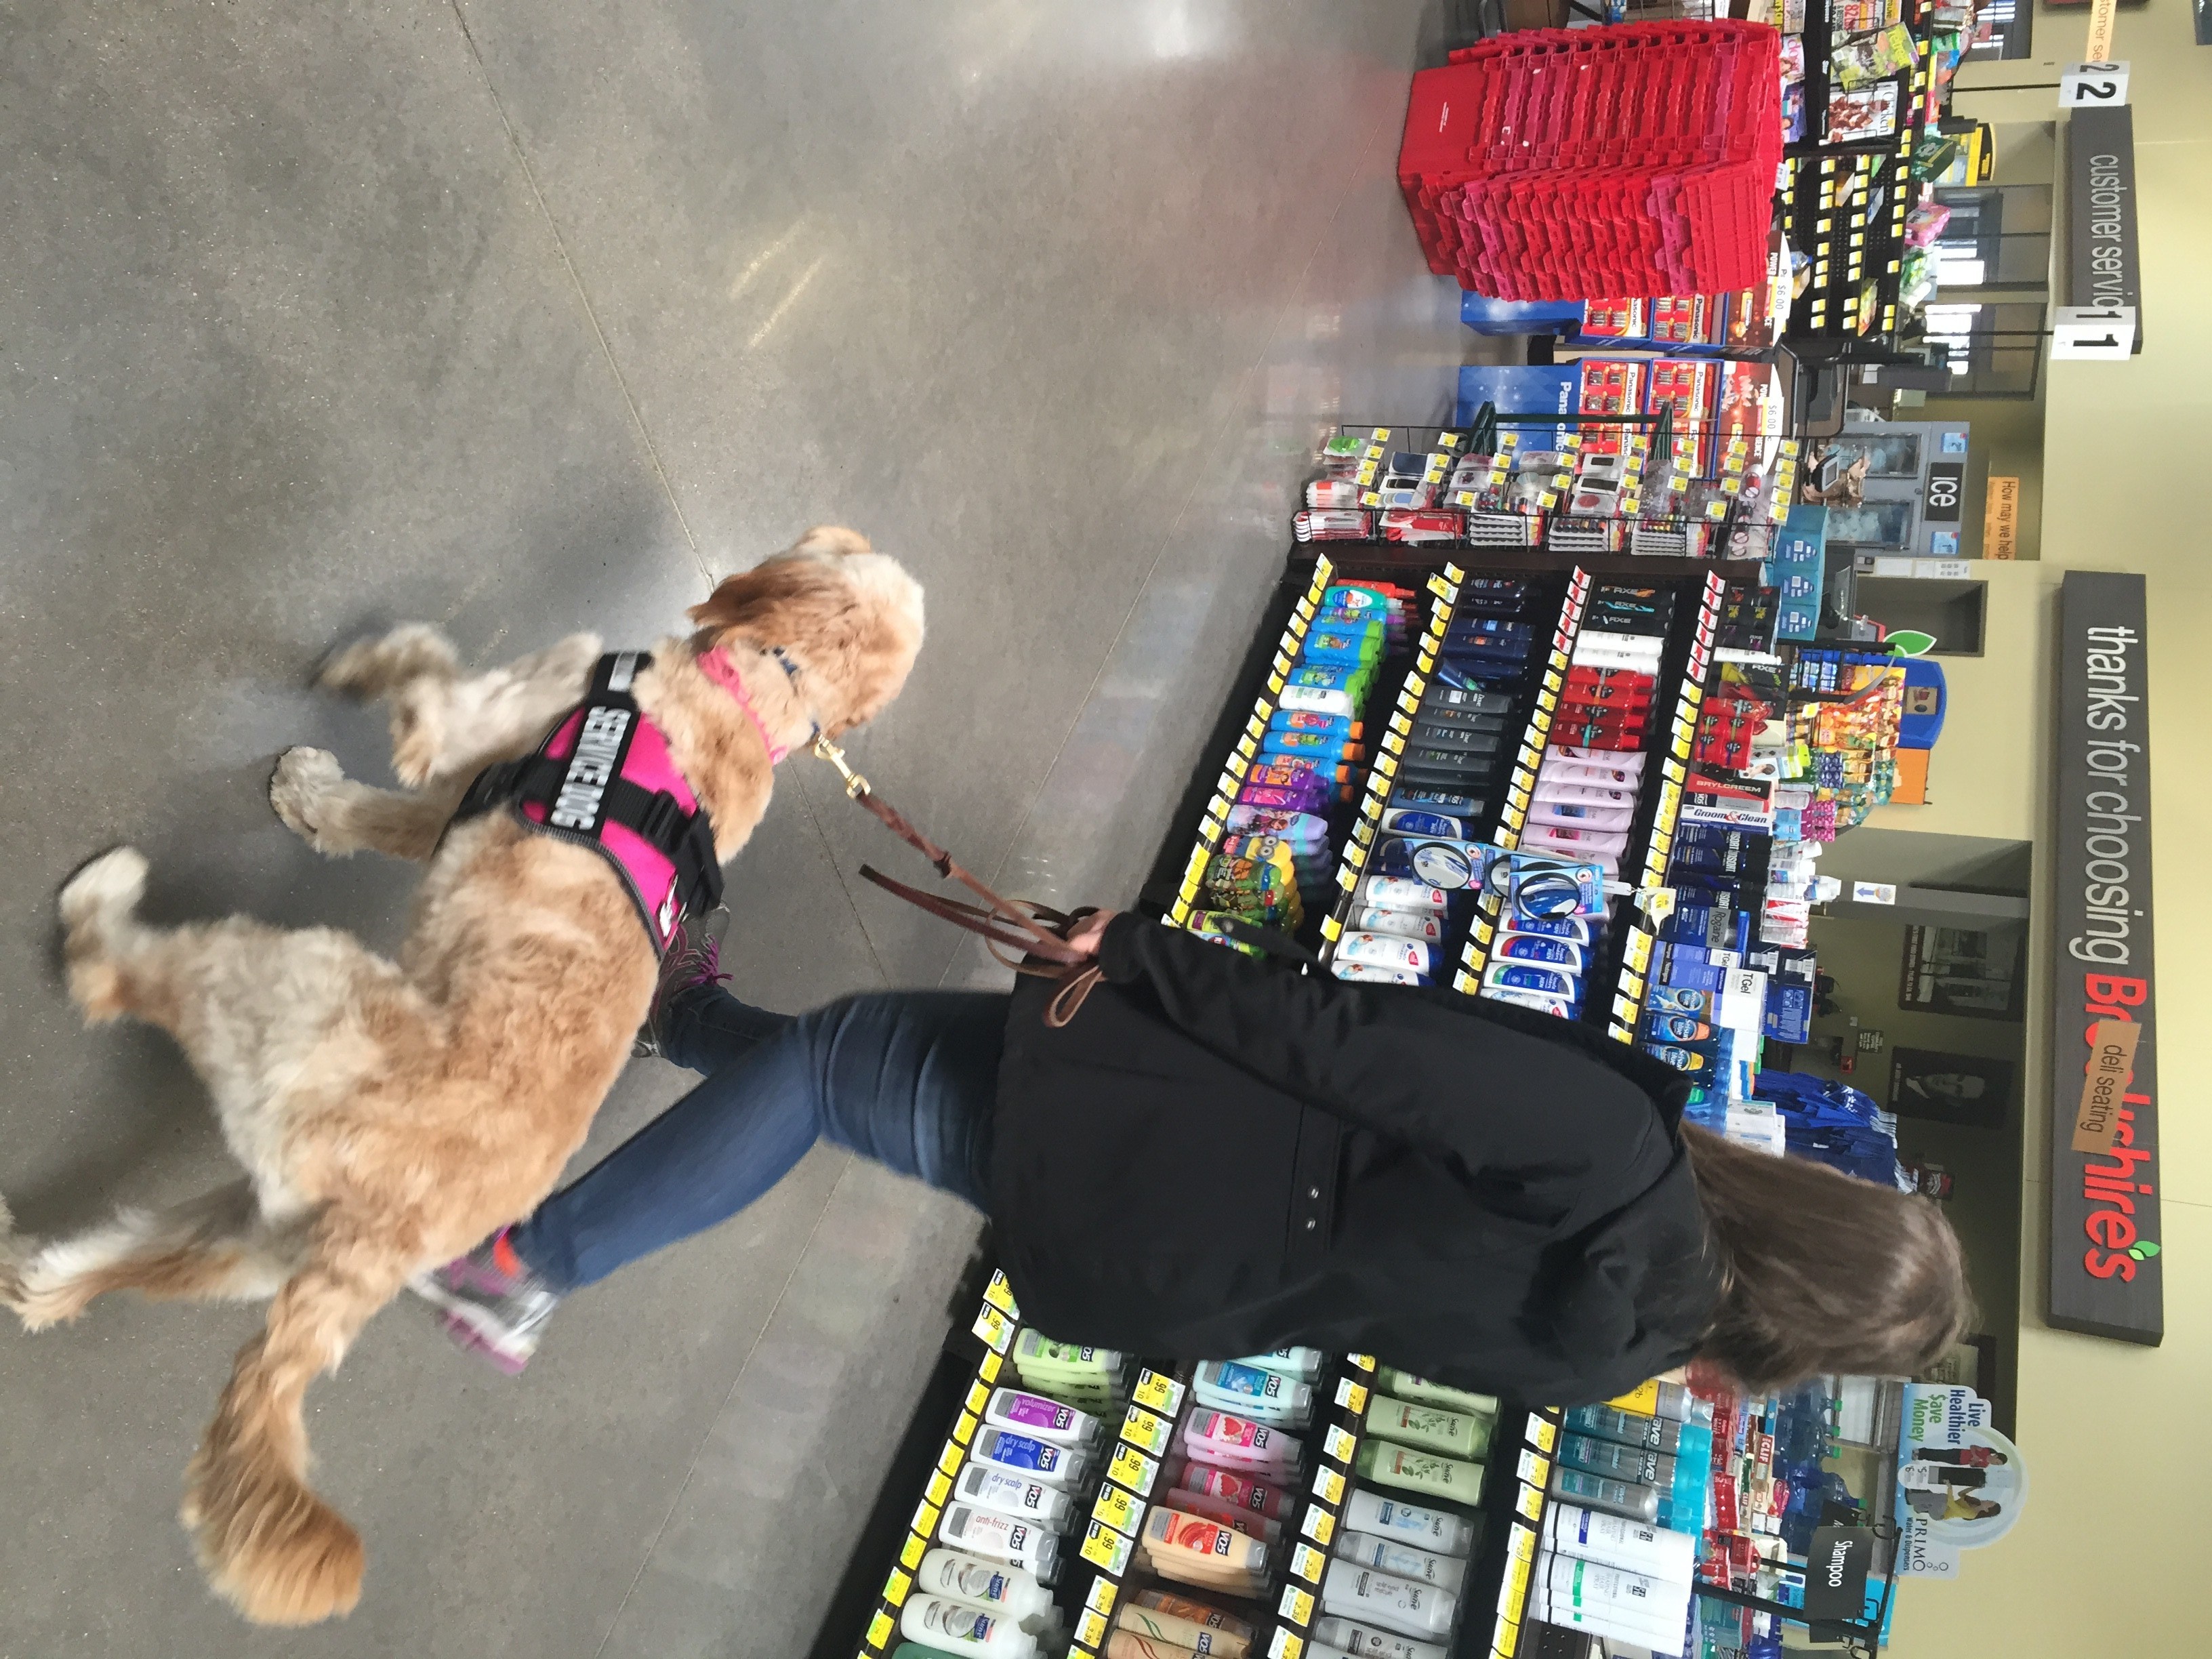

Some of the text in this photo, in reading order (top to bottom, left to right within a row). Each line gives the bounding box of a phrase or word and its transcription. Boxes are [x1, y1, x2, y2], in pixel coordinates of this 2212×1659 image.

[2080, 64, 2119, 73] 2
[2076, 82, 2116, 100] 2
[1879, 91, 1895, 134] Chicken
[2089, 155, 2133, 307] customer servic
[1769, 252, 1778, 275] POWER
[1692, 298, 1703, 339] Panasonic
[2076, 310, 2123, 319] 1
[2073, 334, 2119, 348] 1
[1625, 372, 1636, 413] Panasonic
[1694, 371, 1704, 412] Panasonic
[1555, 381, 1572, 451] Panaonic
[1994, 480, 2015, 560] How may we help
[1475, 693, 1485, 707] Dove
[550, 705, 632, 830] SERVICE DOG
[1696, 780, 1761, 793] BRYLCREEM
[1694, 808, 1727, 819] Groom
[1738, 813, 1767, 823] Clean
[1710, 910, 1727, 943] Rogaine
[2068, 626, 2154, 1283] thanks for choosing Brhire's
[1682, 1019, 1692, 1040] Selsun
[2078, 1044, 2128, 1133] deli seating
[1082, 1347, 1092, 1361] O5
[1266, 1376, 1279, 1397] VO5
[1021, 1399, 1056, 1412] volumizer
[1347, 1393, 1357, 1409] 2.39
[1928, 1394, 1949, 1424] $ave
[1055, 1408, 1069, 1428] VO5
[1907, 1399, 1929, 1442] Money
[1947, 1389, 1967, 1445] Healthier
[1967, 1403, 1986, 1427] Live
[1448, 1417, 1459, 1437] Suave
[1650, 1418, 1662, 1446] rave
[1005, 1435, 1036, 1453] dry scalp
[1255, 1428, 1268, 1449] VO5
[1040, 1448, 1054, 1470] VO5
[1334, 1441, 1345, 1458] 2.39
[1759, 1443, 1769, 1462] CLIF
[1442, 1463, 1454, 1484] Suave
[1645, 1452, 1658, 1481] rave
[991, 1473, 1023, 1491] dry scalp
[1324, 1481, 1334, 1500] 2.39
[1026, 1486, 1040, 1508] VO5
[1252, 1488, 1265, 1509] VO5
[1618, 1485, 1626, 1504] rave
[975, 1516, 1009, 1531] anti-frizz
[1313, 1522, 1323, 1540] 2.39
[1432, 1517, 1443, 1538] Suave
[1906, 1517, 1914, 1534] Water
[1011, 1528, 1025, 1550] VO5
[1216, 1532, 1229, 1555] VO5
[1912, 1518, 1928, 1572] PRIMO
[1826, 1540, 1853, 1587] Shampoo
[1903, 1540, 1913, 1571] Dispensers
[1303, 1559, 1313, 1578] 2.39
[1425, 1558, 1437, 1580] Suave
[991, 1577, 1004, 1599] Suave
[1291, 1601, 1302, 1620] 2.39
[1410, 1589, 1422, 1611] Suave
[977, 1618, 989, 1639] Suave
[1198, 1633, 1210, 1654] VO5
[1406, 1645, 1415, 1659] Sua
